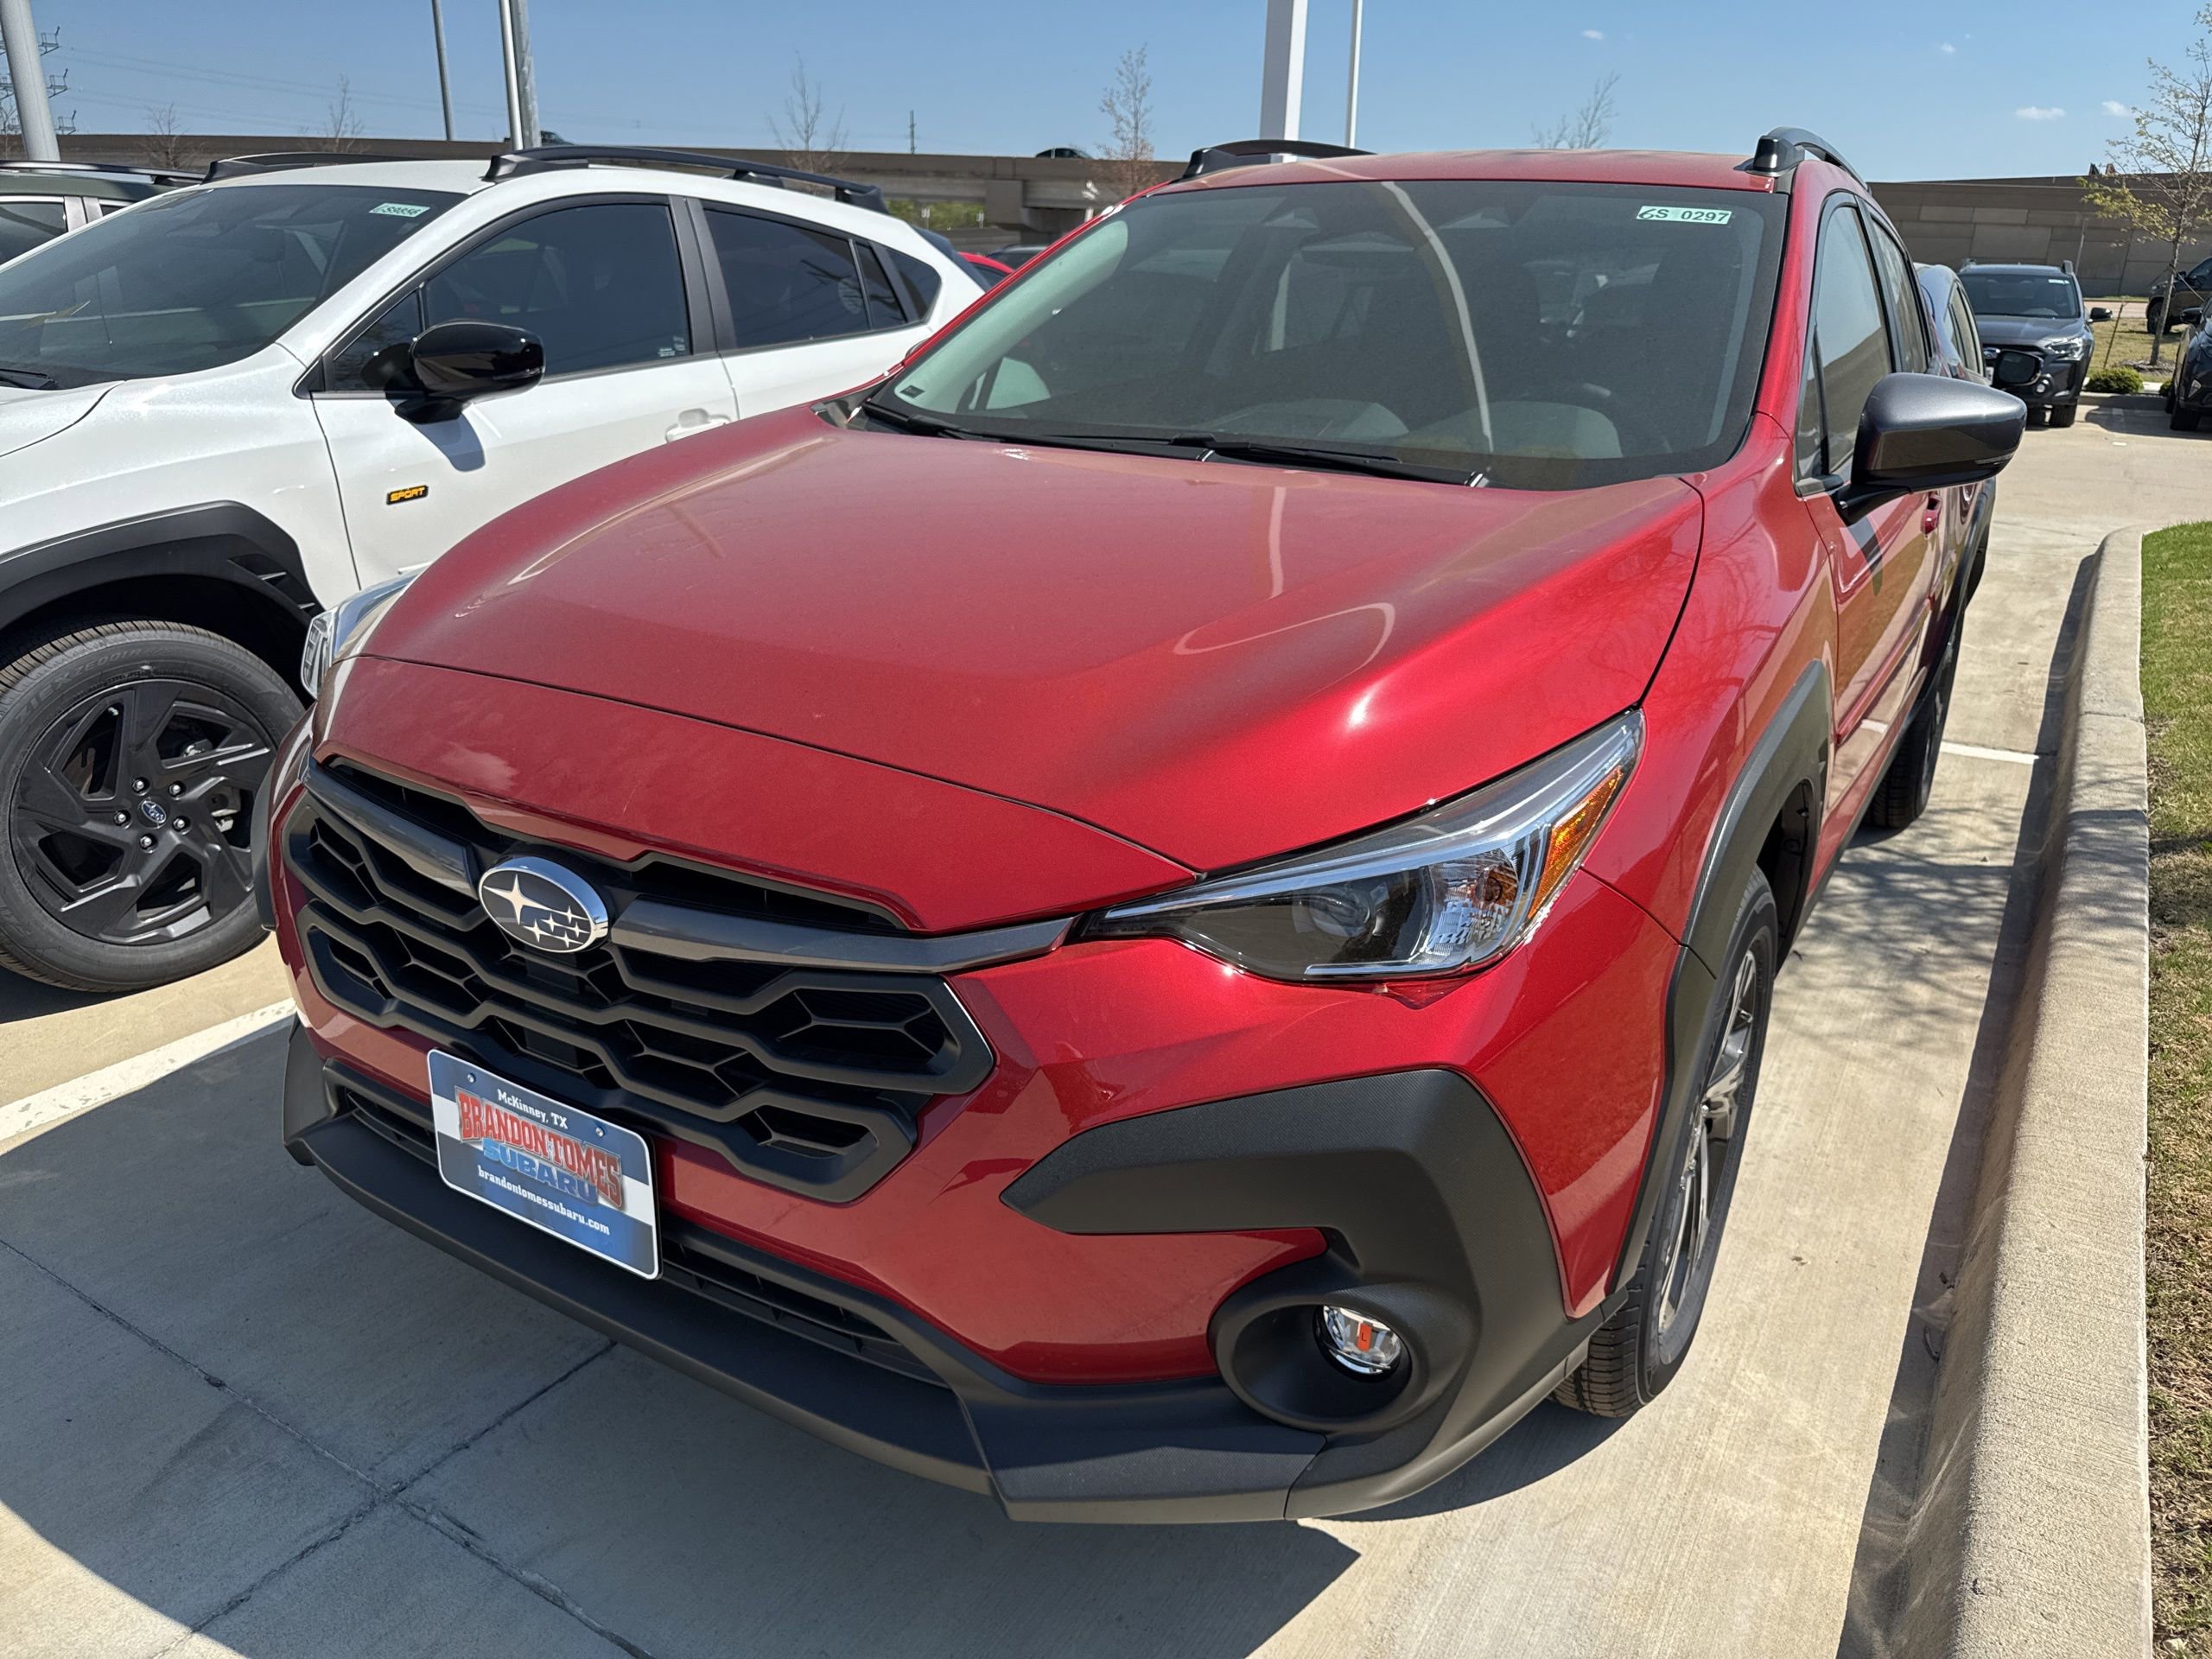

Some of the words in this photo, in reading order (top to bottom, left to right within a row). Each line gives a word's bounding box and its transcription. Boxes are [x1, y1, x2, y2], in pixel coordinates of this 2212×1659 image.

[1681, 210, 1730, 222] 0297
[390, 486, 425, 502] SPORT
[498, 1089, 549, 1122] McKinney,
[550, 1112, 569, 1129] TX
[458, 1091, 548, 1158] BRANDON
[546, 1132, 623, 1209] TOMES
[483, 1138, 598, 1204] SUBARU
[478, 1165, 610, 1236] brandontomessubaru.com
